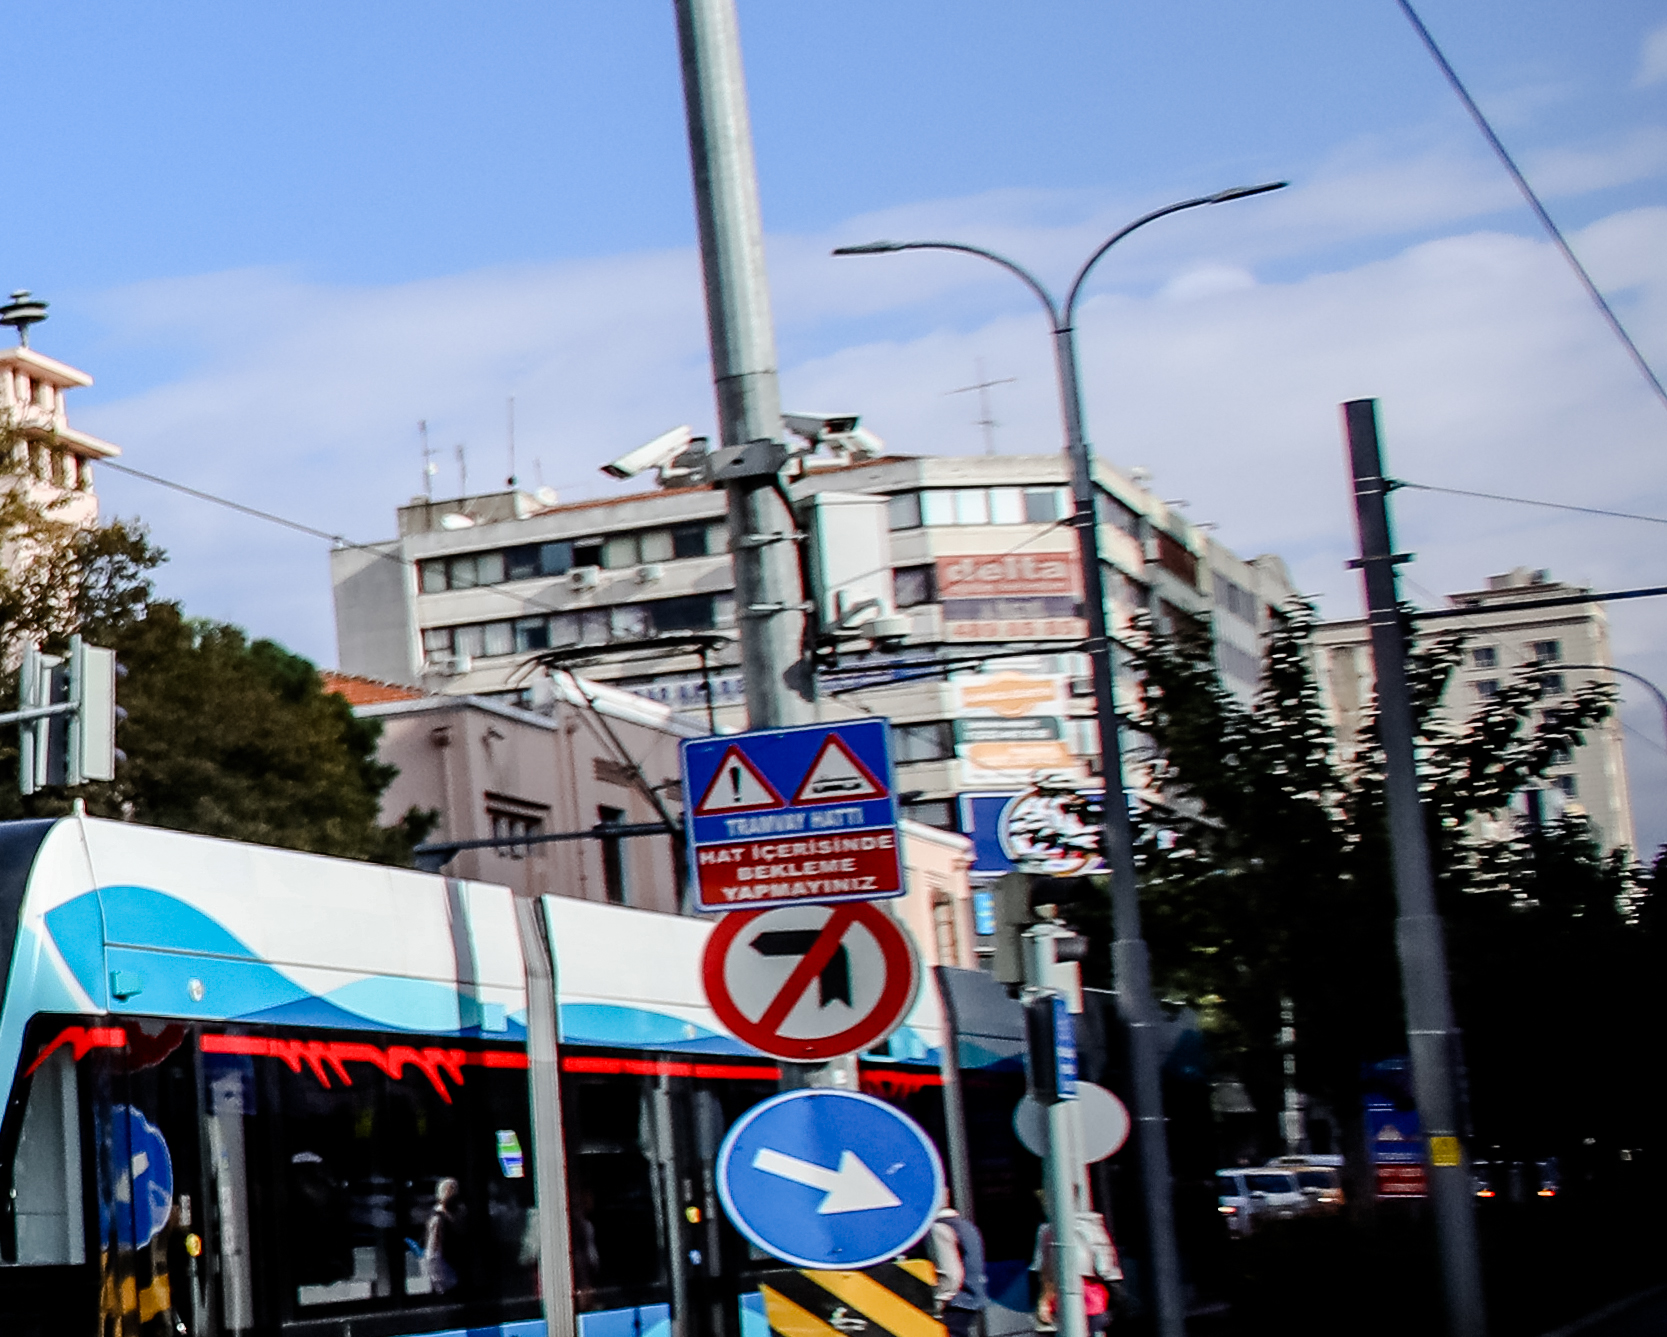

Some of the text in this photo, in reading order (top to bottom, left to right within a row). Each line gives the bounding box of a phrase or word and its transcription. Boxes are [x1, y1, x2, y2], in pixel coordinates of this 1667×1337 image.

[946, 556, 1068, 582] delta
[699, 834, 895, 865] HAT İÇERİSİNDE
[736, 858, 857, 881] BEKLEME
[720, 876, 879, 902] YAPMAYINIZ
